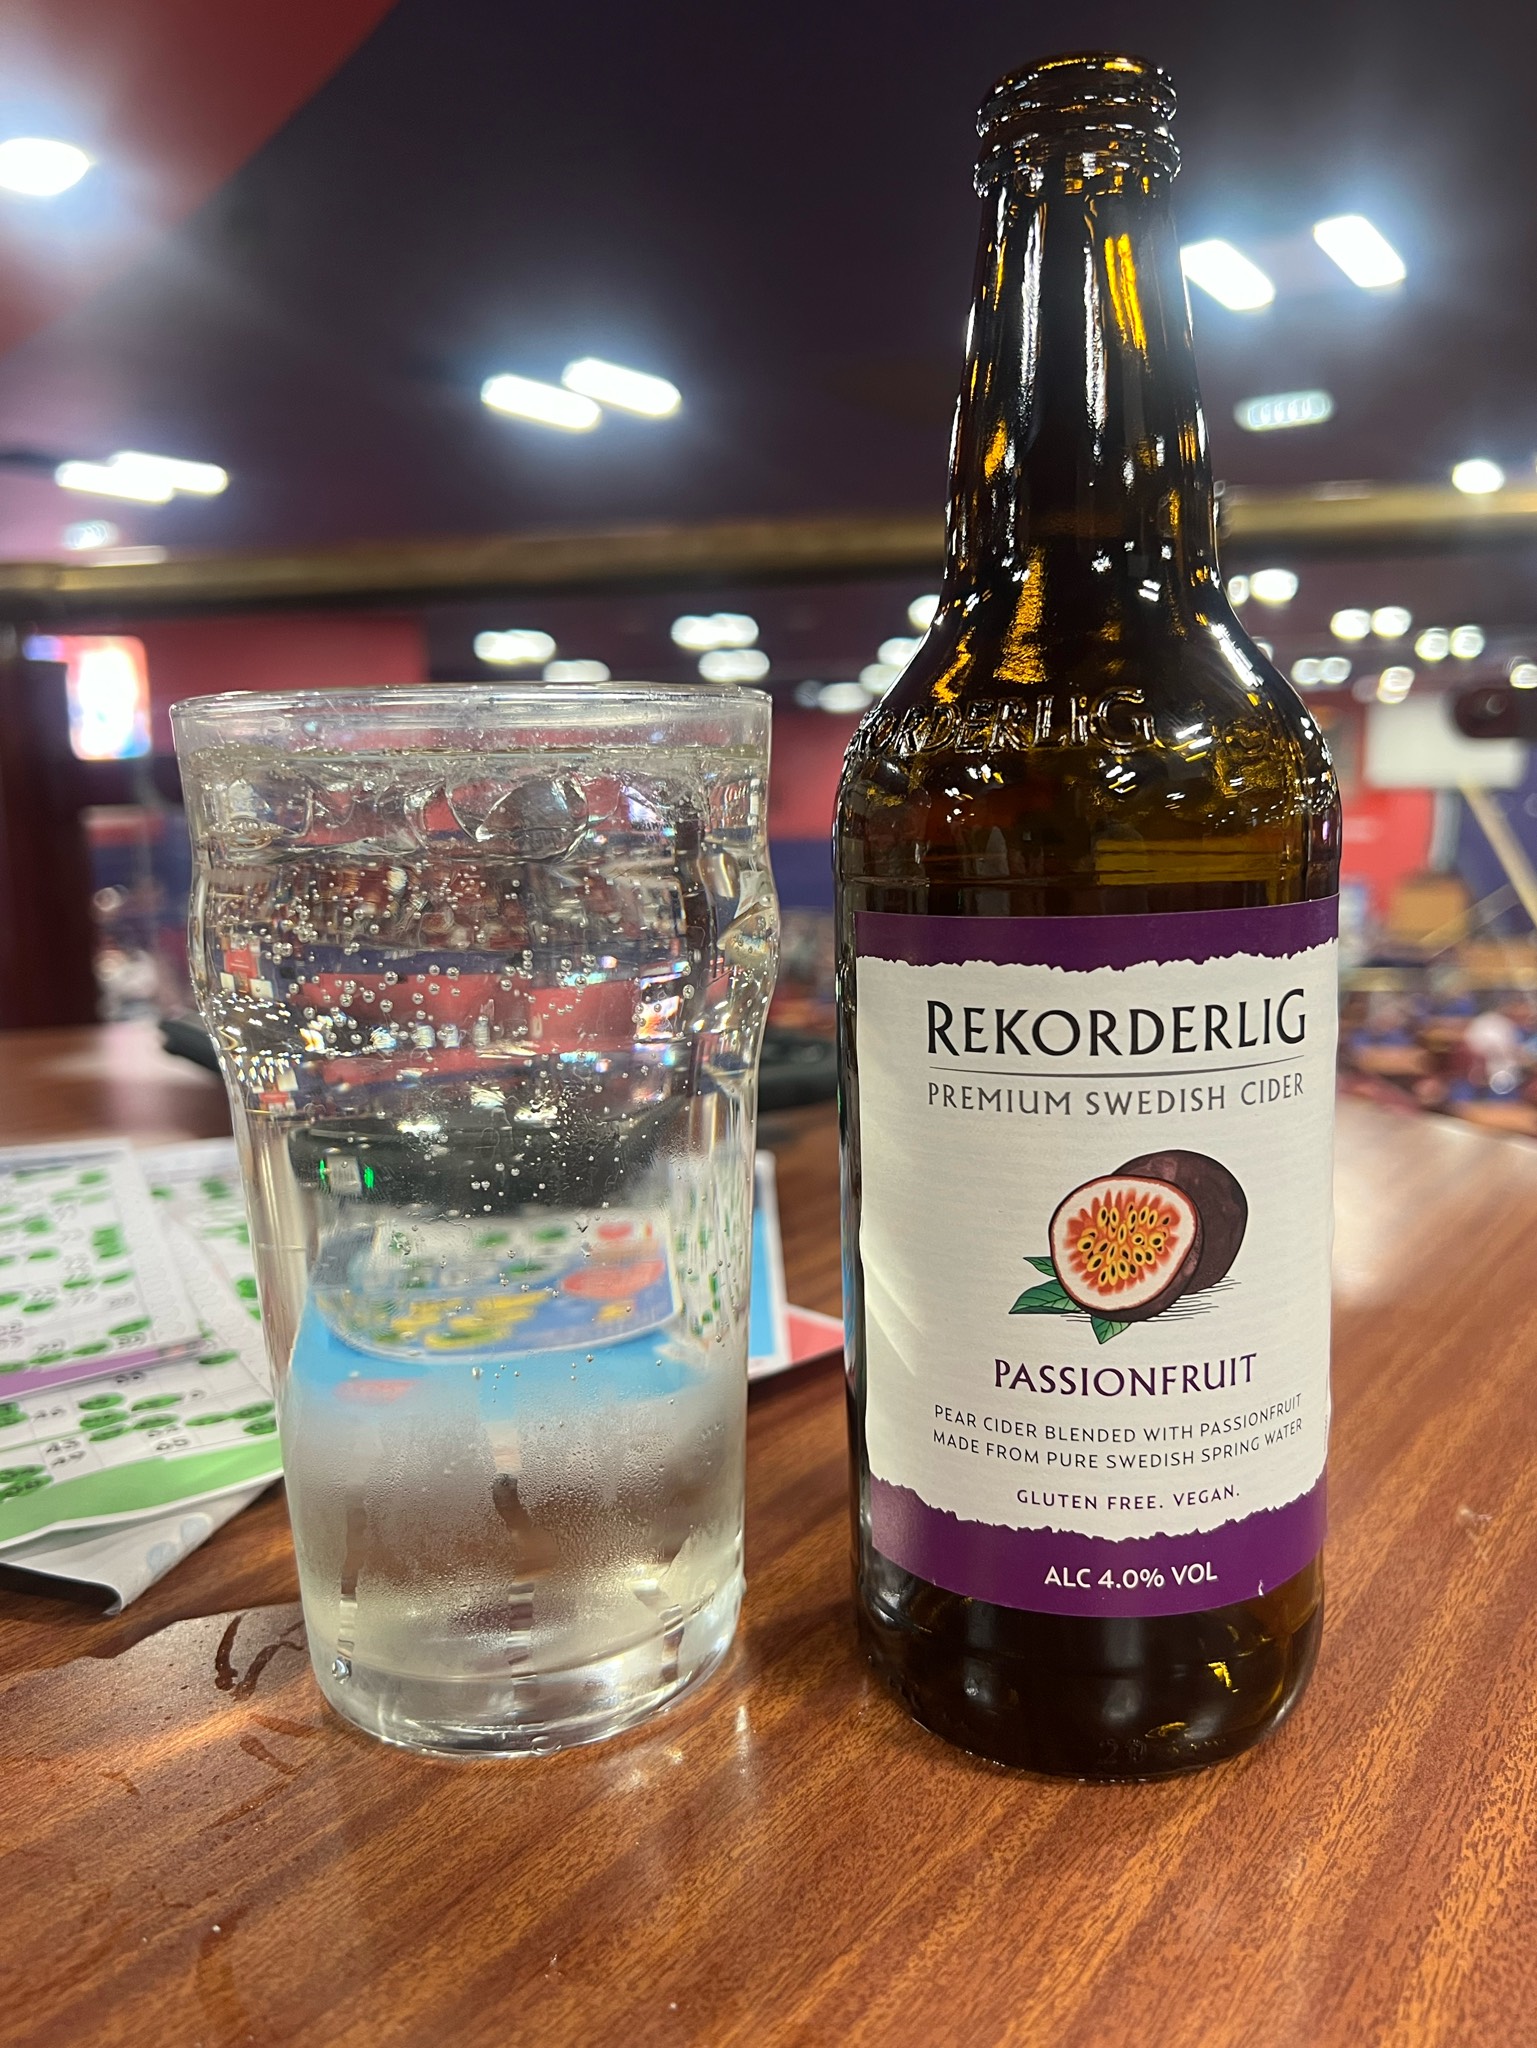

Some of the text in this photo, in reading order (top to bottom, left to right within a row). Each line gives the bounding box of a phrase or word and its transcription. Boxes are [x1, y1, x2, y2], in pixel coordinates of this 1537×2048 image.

[926, 987, 1307, 1057] REKORDERLIG
[928, 1072, 1305, 1117] PREMIUM SWEDISH CIDER
[994, 1352, 1258, 1398] PASSIONFRUIT
[933, 1403, 978, 1430] PEAR
[983, 1416, 1038, 1440] CIDER
[1044, 1425, 1136, 1444] BLENDED
[1142, 1424, 1194, 1443] WITH
[1200, 1391, 1303, 1438] PASSIONFRUIT
[932, 1427, 981, 1456] MADE
[985, 1440, 1040, 1466] FROM
[1046, 1451, 1099, 1470] PURE
[1105, 1450, 1195, 1470] SWEDISH
[1200, 1435, 1261, 1464] SPRING
[1264, 1416, 1304, 1447] WATER
[1016, 1482, 1243, 1512] GLUTEN FREE. VEGAN.
[1043, 1560, 1220, 1591] ALC 4.0% VOL
